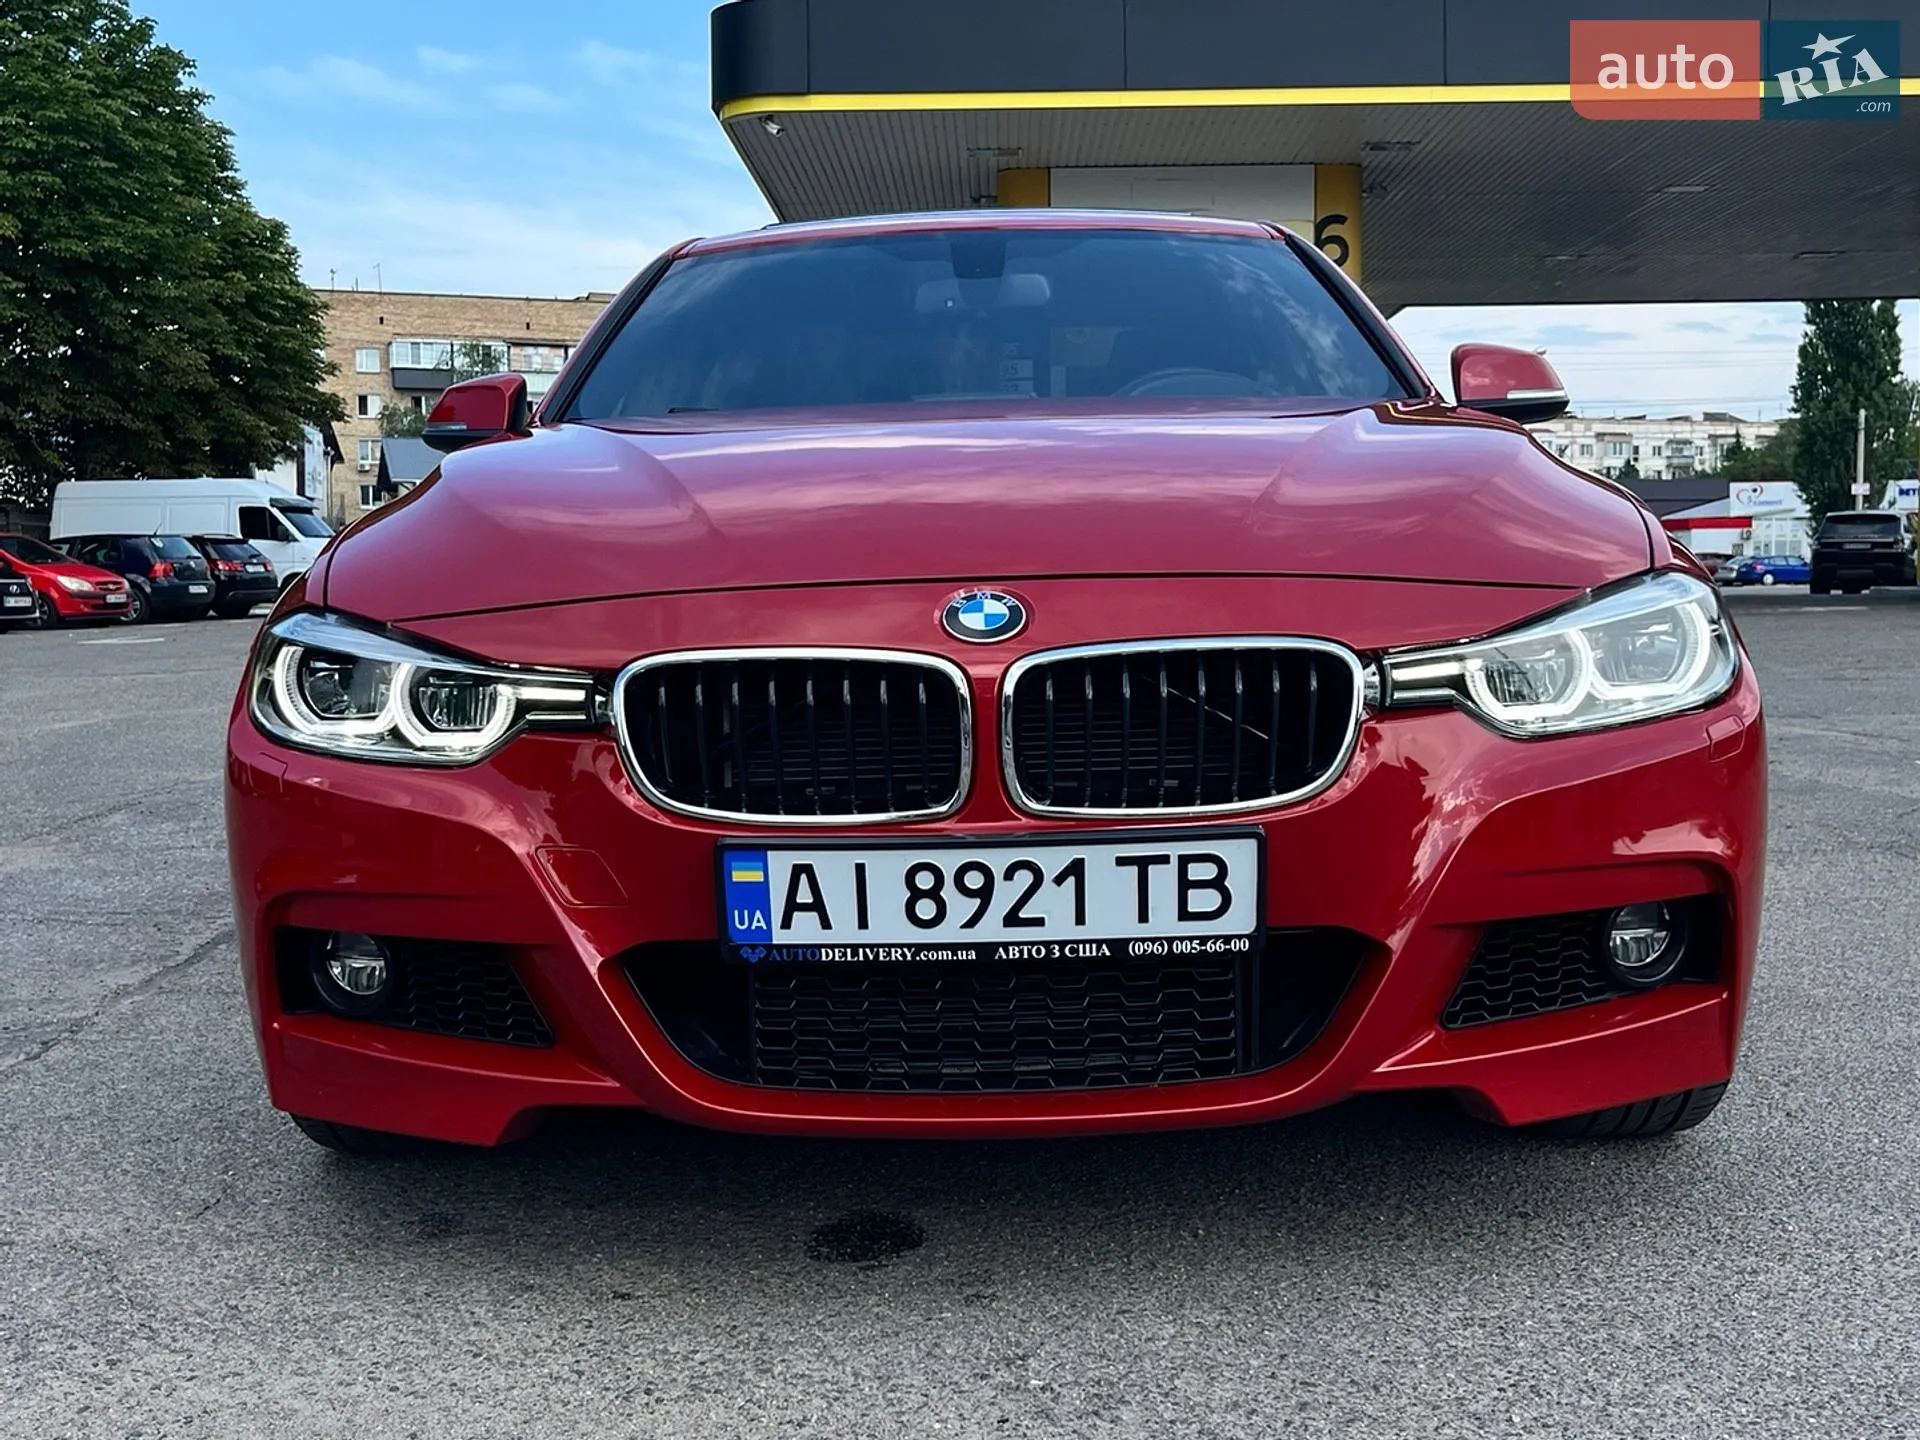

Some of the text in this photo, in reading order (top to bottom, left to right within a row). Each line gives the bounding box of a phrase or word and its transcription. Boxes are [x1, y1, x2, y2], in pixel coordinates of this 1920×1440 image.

[1315, 214, 1348, 267] 6
[952, 592, 1016, 608] BMW
[779, 852, 1234, 931] AI 8921 TB
[733, 909, 768, 931] UA
[768, 947, 977, 962] AUTODELIVERY.com.ua
[994, 944, 1047, 960] АВТО
[1064, 943, 1112, 959] США
[1128, 937, 1250, 957] (096) 005-66-00
